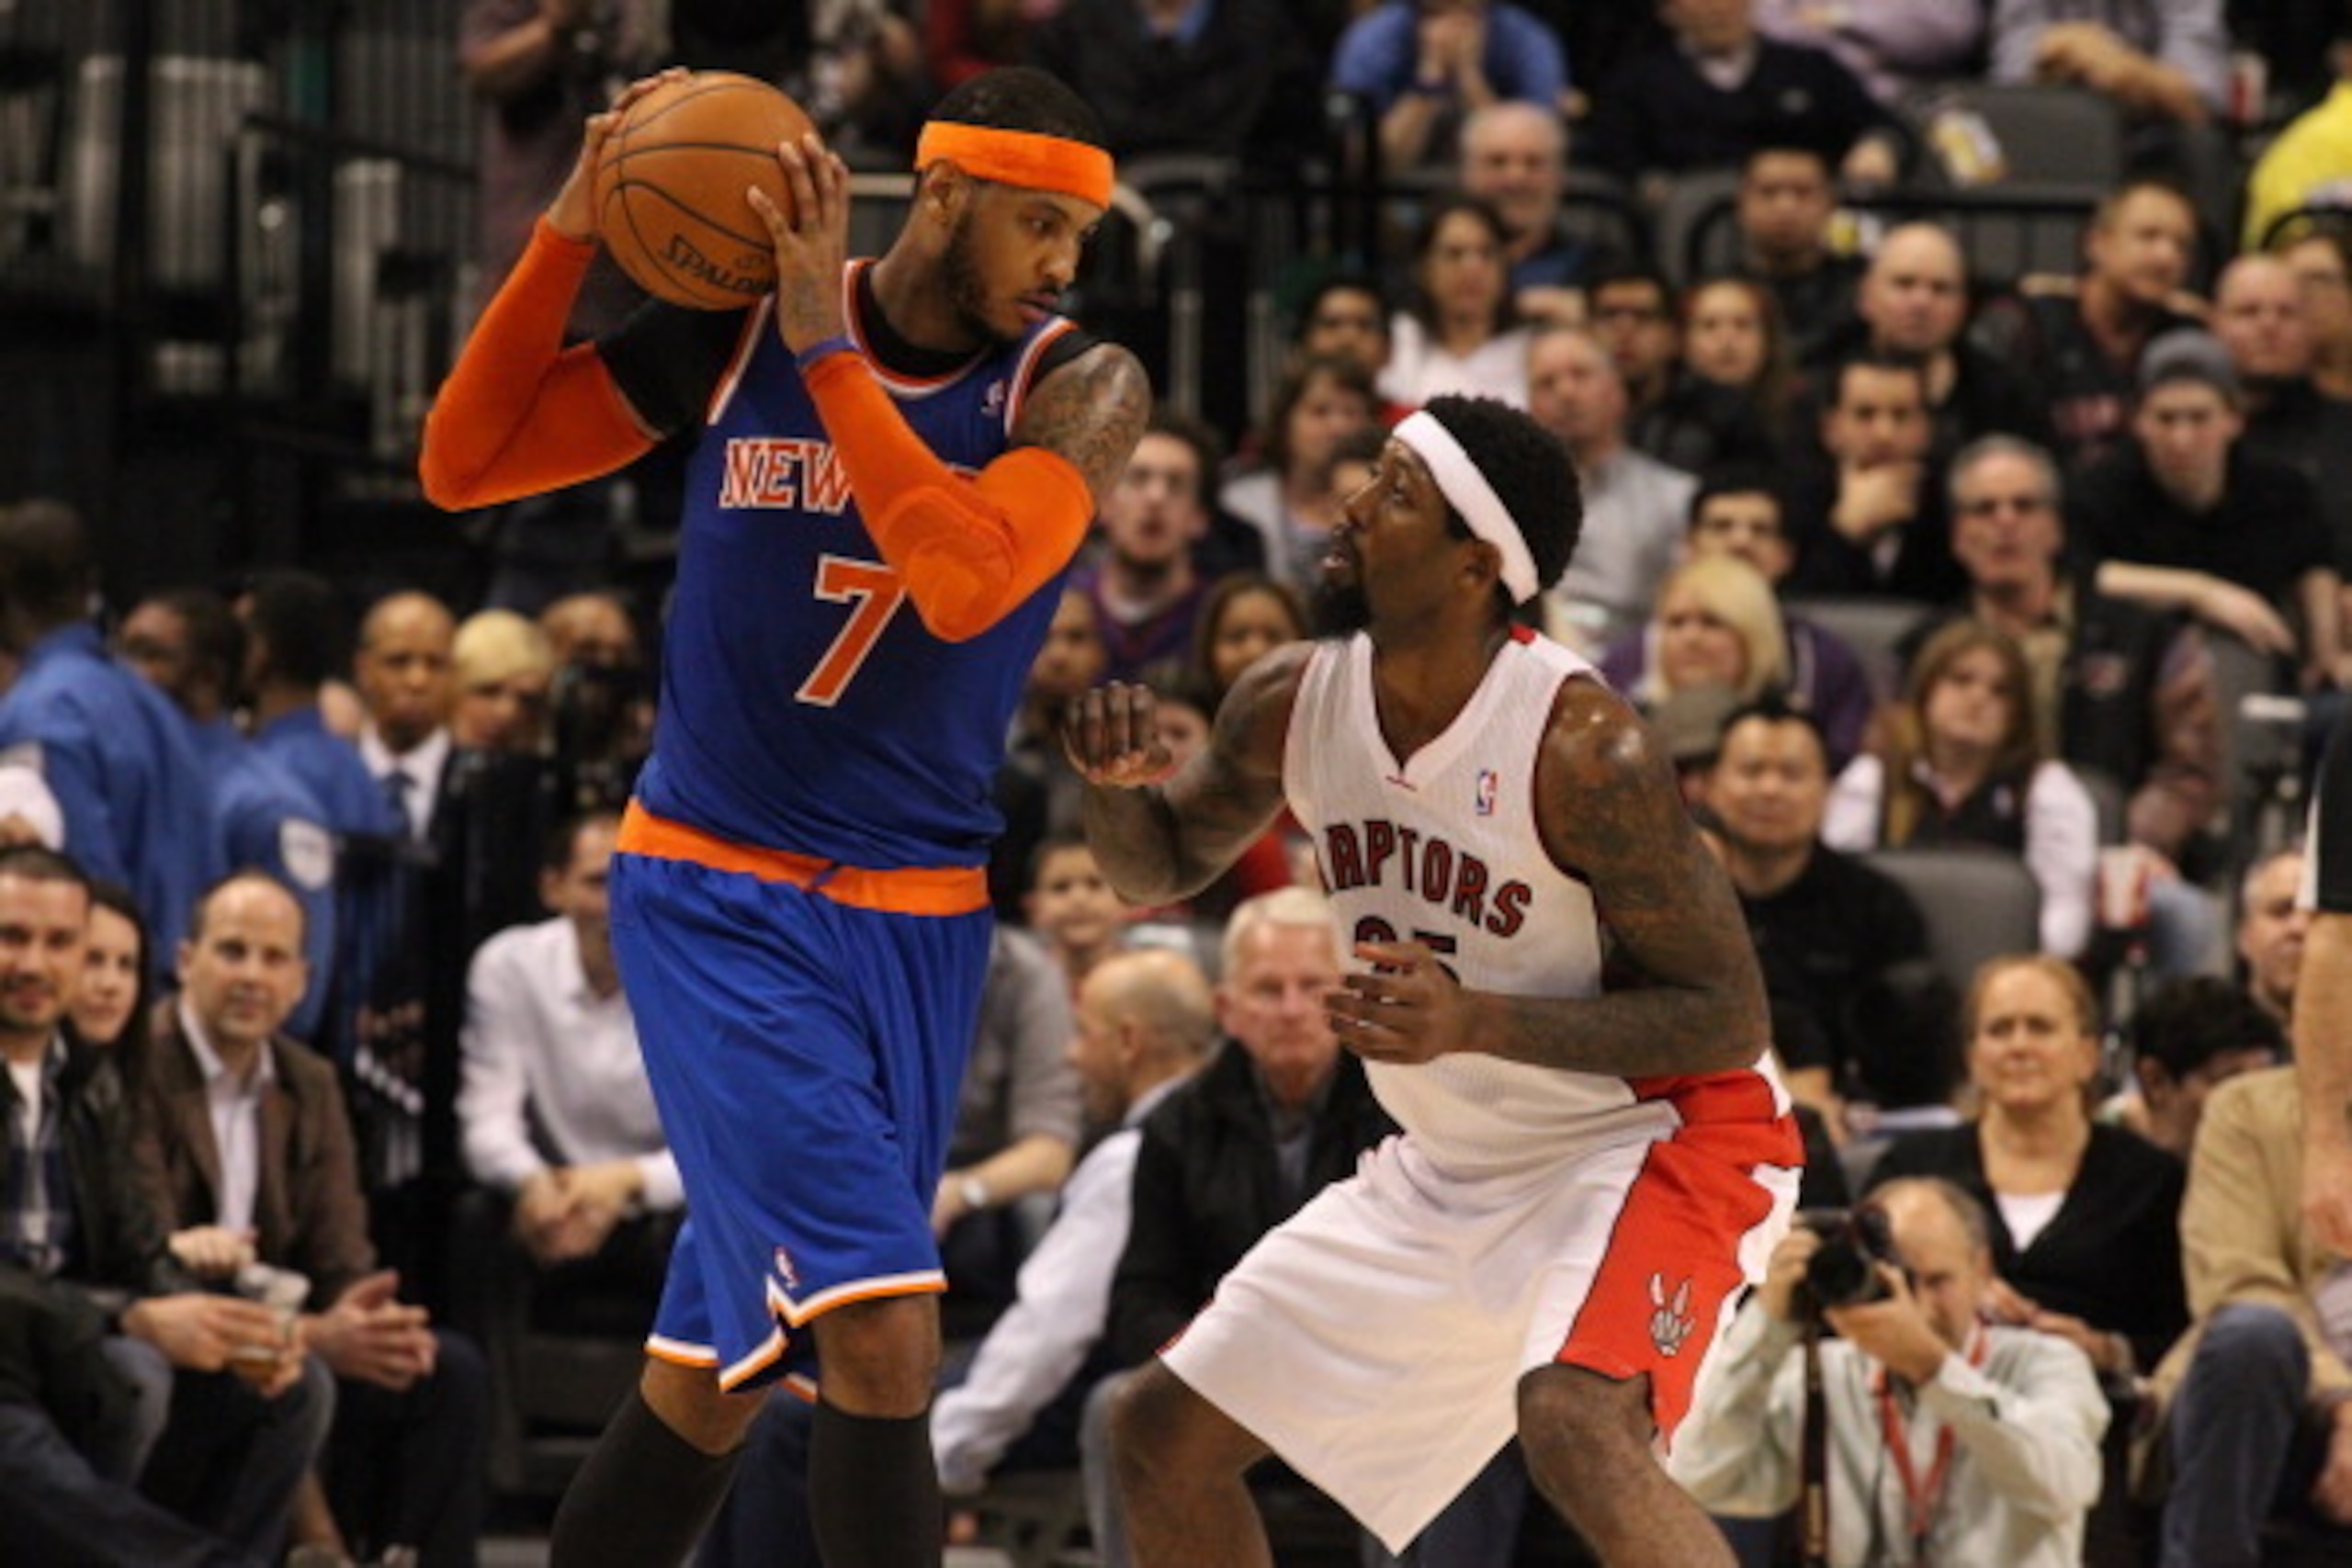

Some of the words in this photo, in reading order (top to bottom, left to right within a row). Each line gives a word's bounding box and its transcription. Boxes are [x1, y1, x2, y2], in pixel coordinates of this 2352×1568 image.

[719, 437, 853, 513] NEW
[795, 554, 908, 707] 7
[1316, 818, 1532, 939] APTORS
